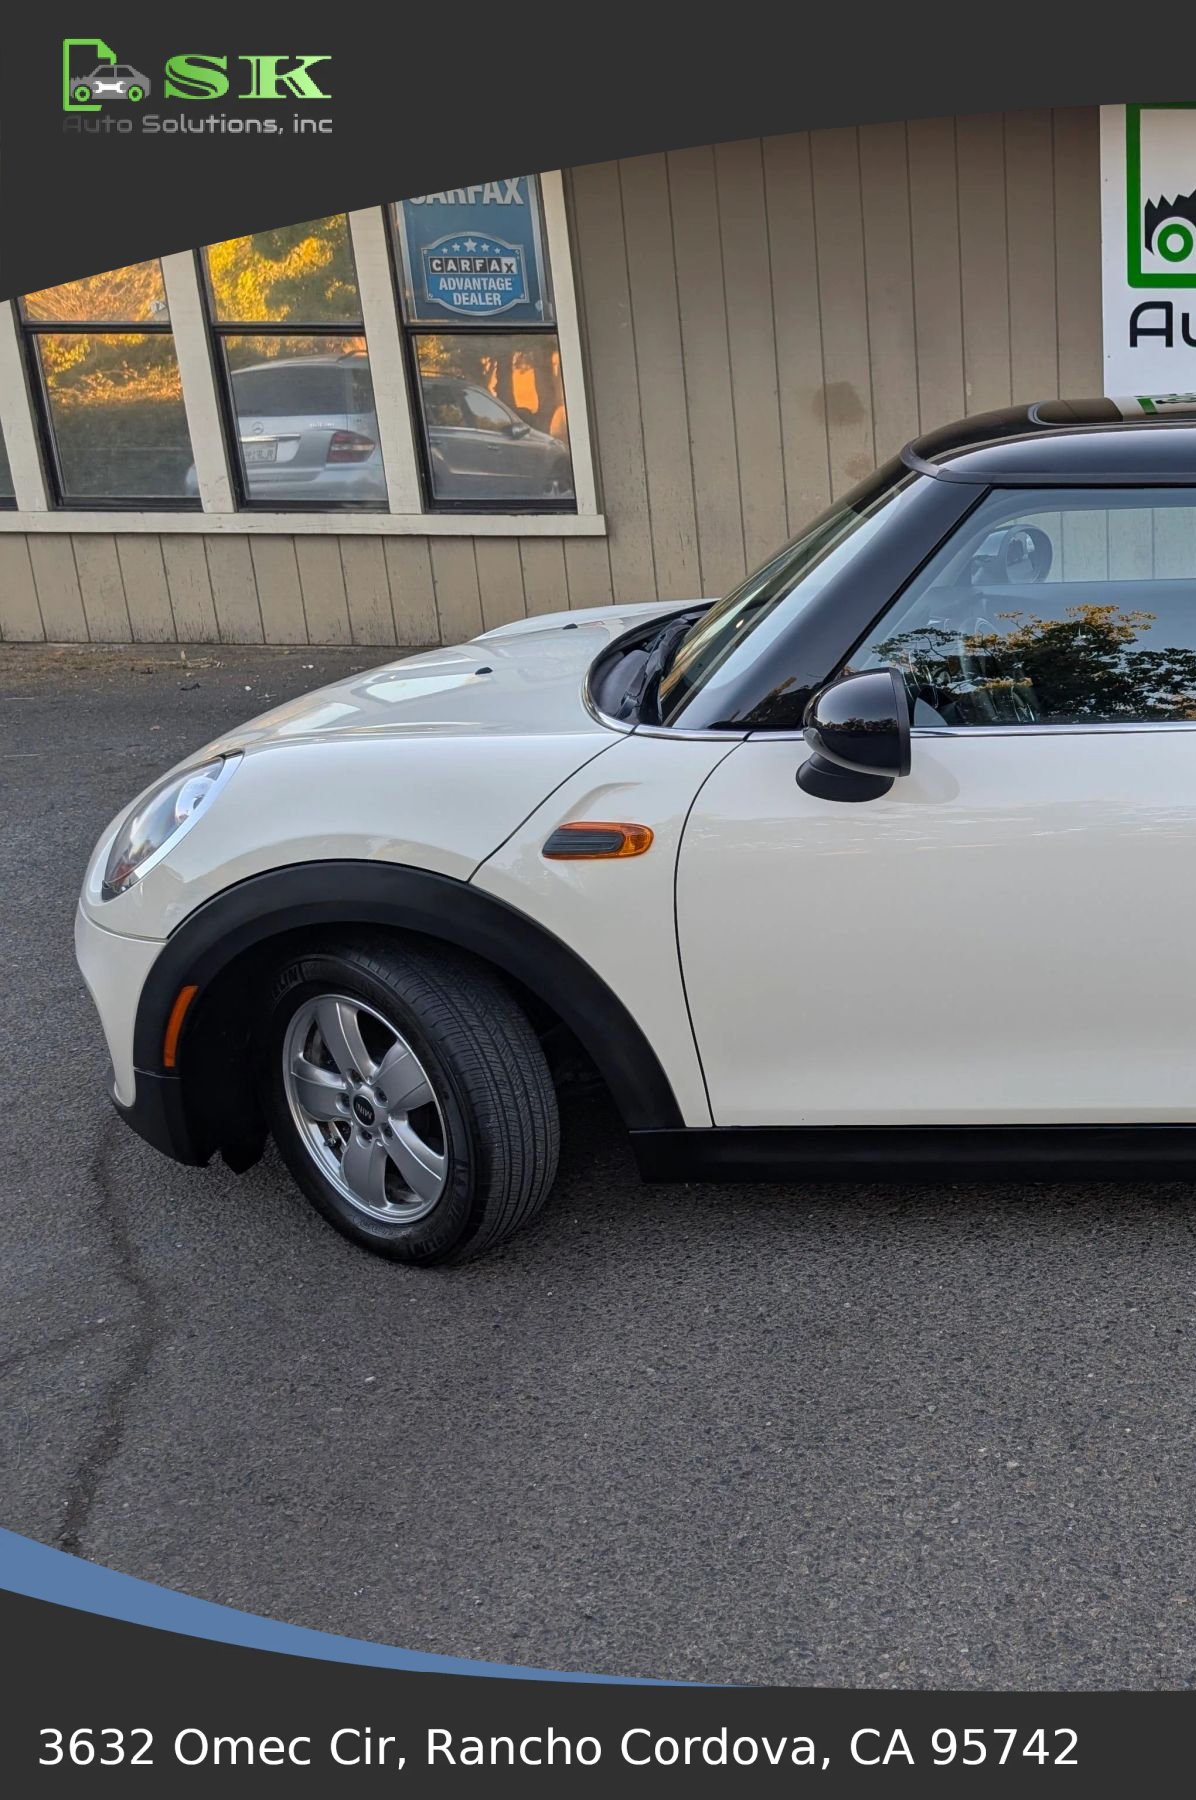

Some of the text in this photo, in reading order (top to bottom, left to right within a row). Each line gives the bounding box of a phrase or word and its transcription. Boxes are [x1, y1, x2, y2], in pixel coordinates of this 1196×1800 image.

[430, 259, 517, 274] CARFAX
[439, 277, 513, 291] ADVANTAGE
[452, 292, 502, 306] DEALER
